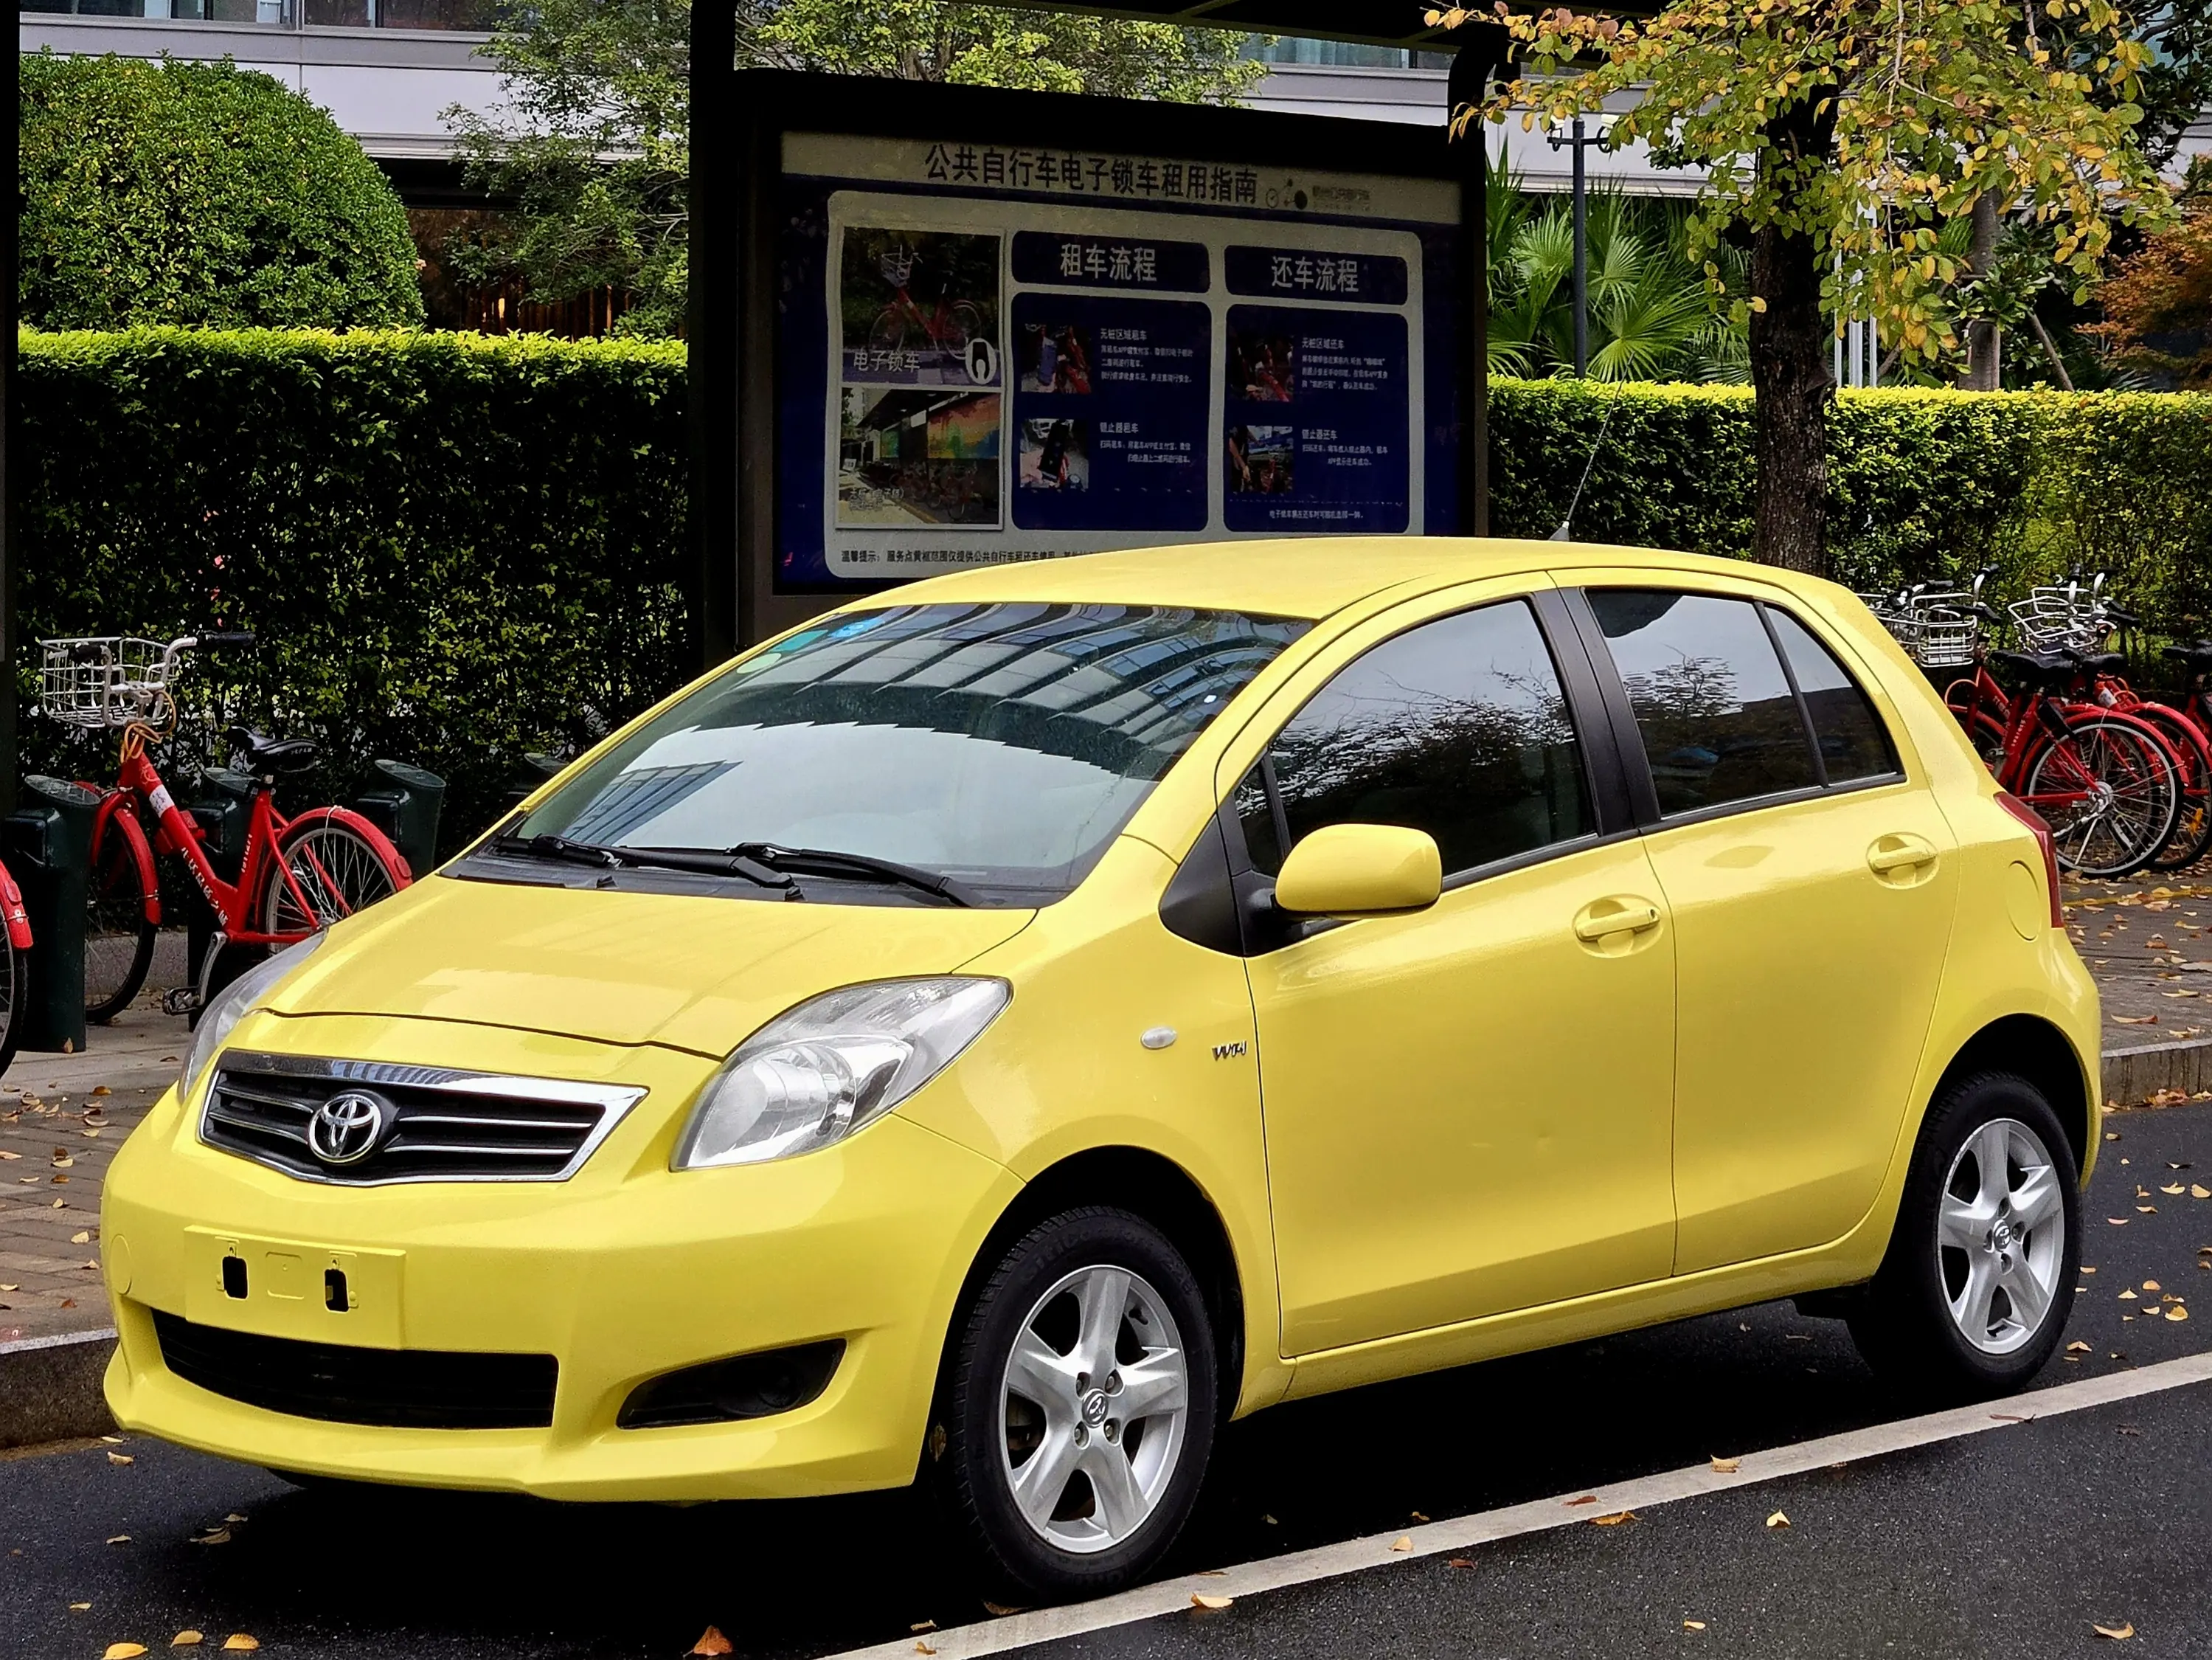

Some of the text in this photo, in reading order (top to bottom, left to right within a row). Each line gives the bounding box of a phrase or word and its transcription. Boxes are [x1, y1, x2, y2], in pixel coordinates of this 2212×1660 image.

[925, 143, 1258, 204] 公共自行车电子锁车租用指南
[1060, 243, 1157, 282] 租车流程
[1271, 255, 1359, 293] 还车流程
[853, 347, 920, 373] 电子锁车
